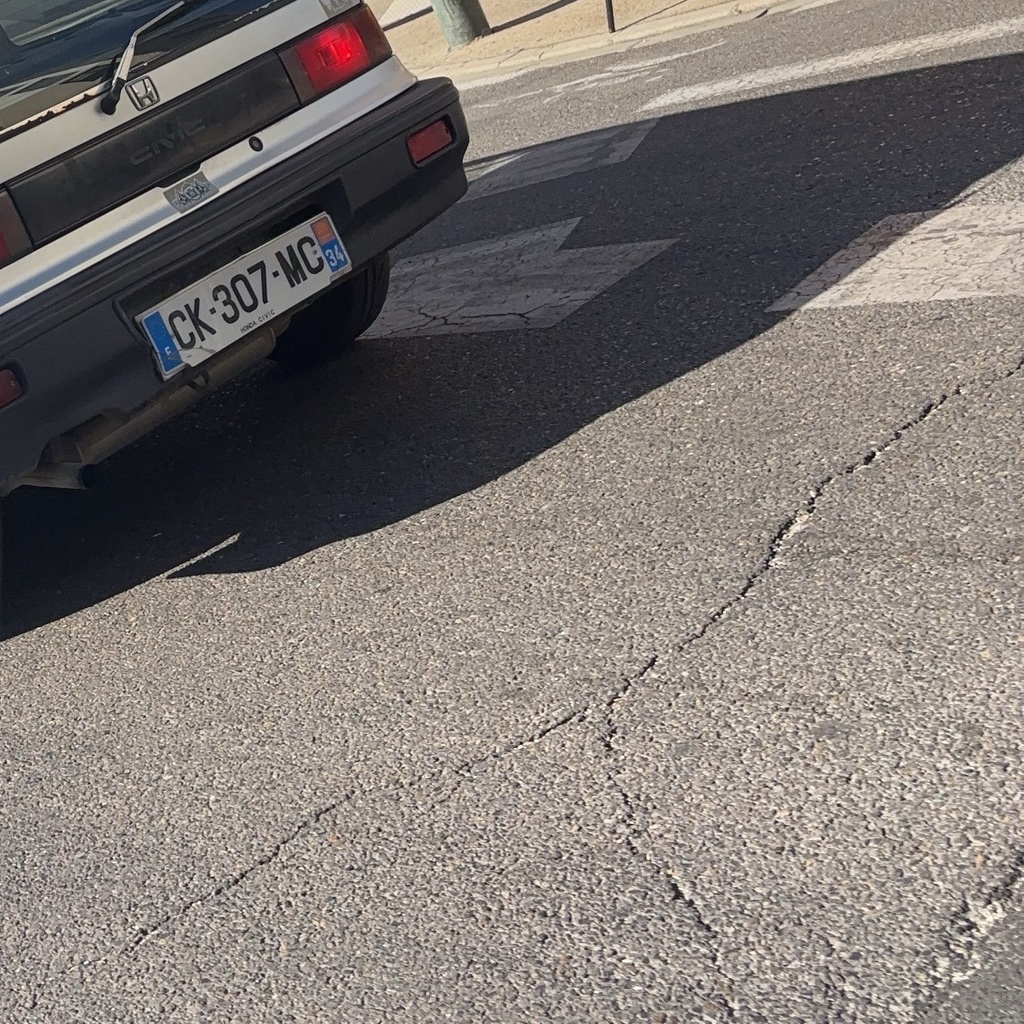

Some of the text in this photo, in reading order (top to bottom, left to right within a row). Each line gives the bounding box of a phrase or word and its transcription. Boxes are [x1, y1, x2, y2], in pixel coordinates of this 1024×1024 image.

[168, 235, 345, 350] CK-307-MC 34
[258, 310, 276, 323] CIVIC
